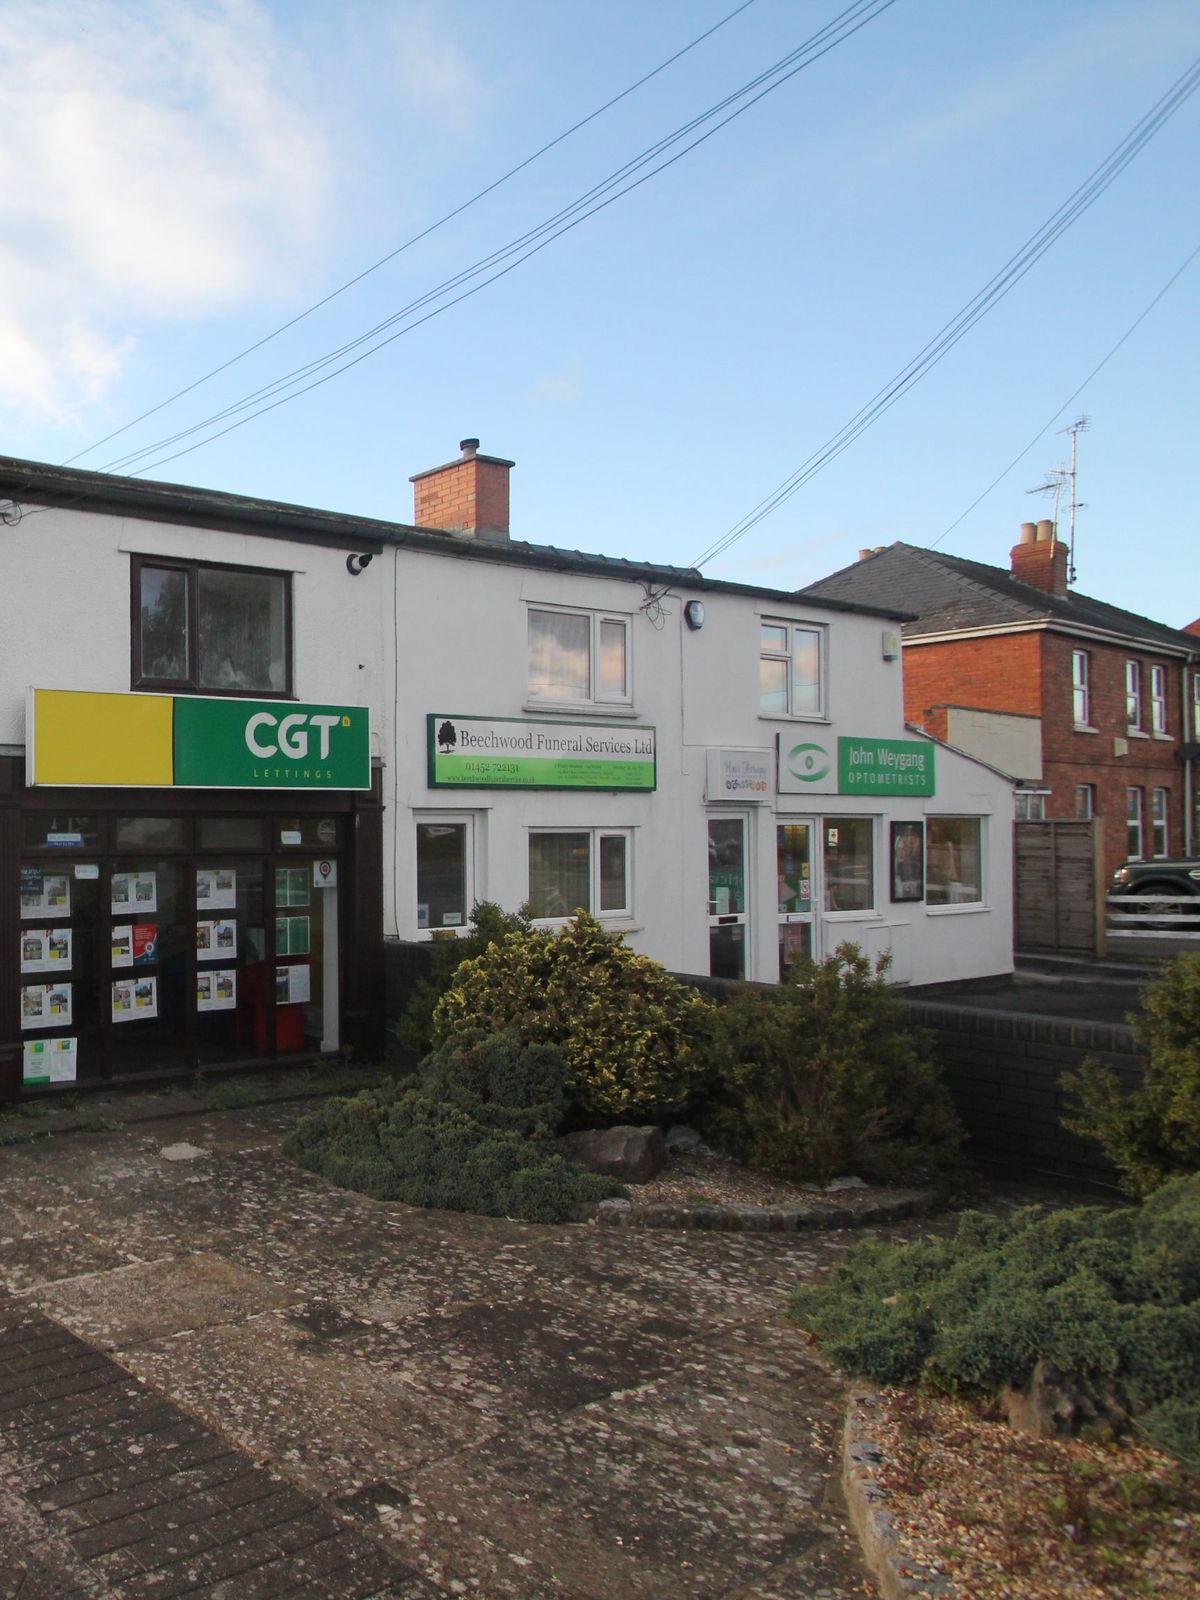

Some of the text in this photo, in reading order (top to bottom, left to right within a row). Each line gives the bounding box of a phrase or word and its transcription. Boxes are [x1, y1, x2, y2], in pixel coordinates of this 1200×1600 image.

[245, 712, 341, 760] CGT
[460, 730, 653, 754] Beechwood Funeral Services Ltd
[465, 762, 490, 774] 01452
[849, 746, 926, 772] John Weygang
[253, 768, 333, 779] LETTINGS
[848, 772, 926, 786] OPTOMETRISTS
